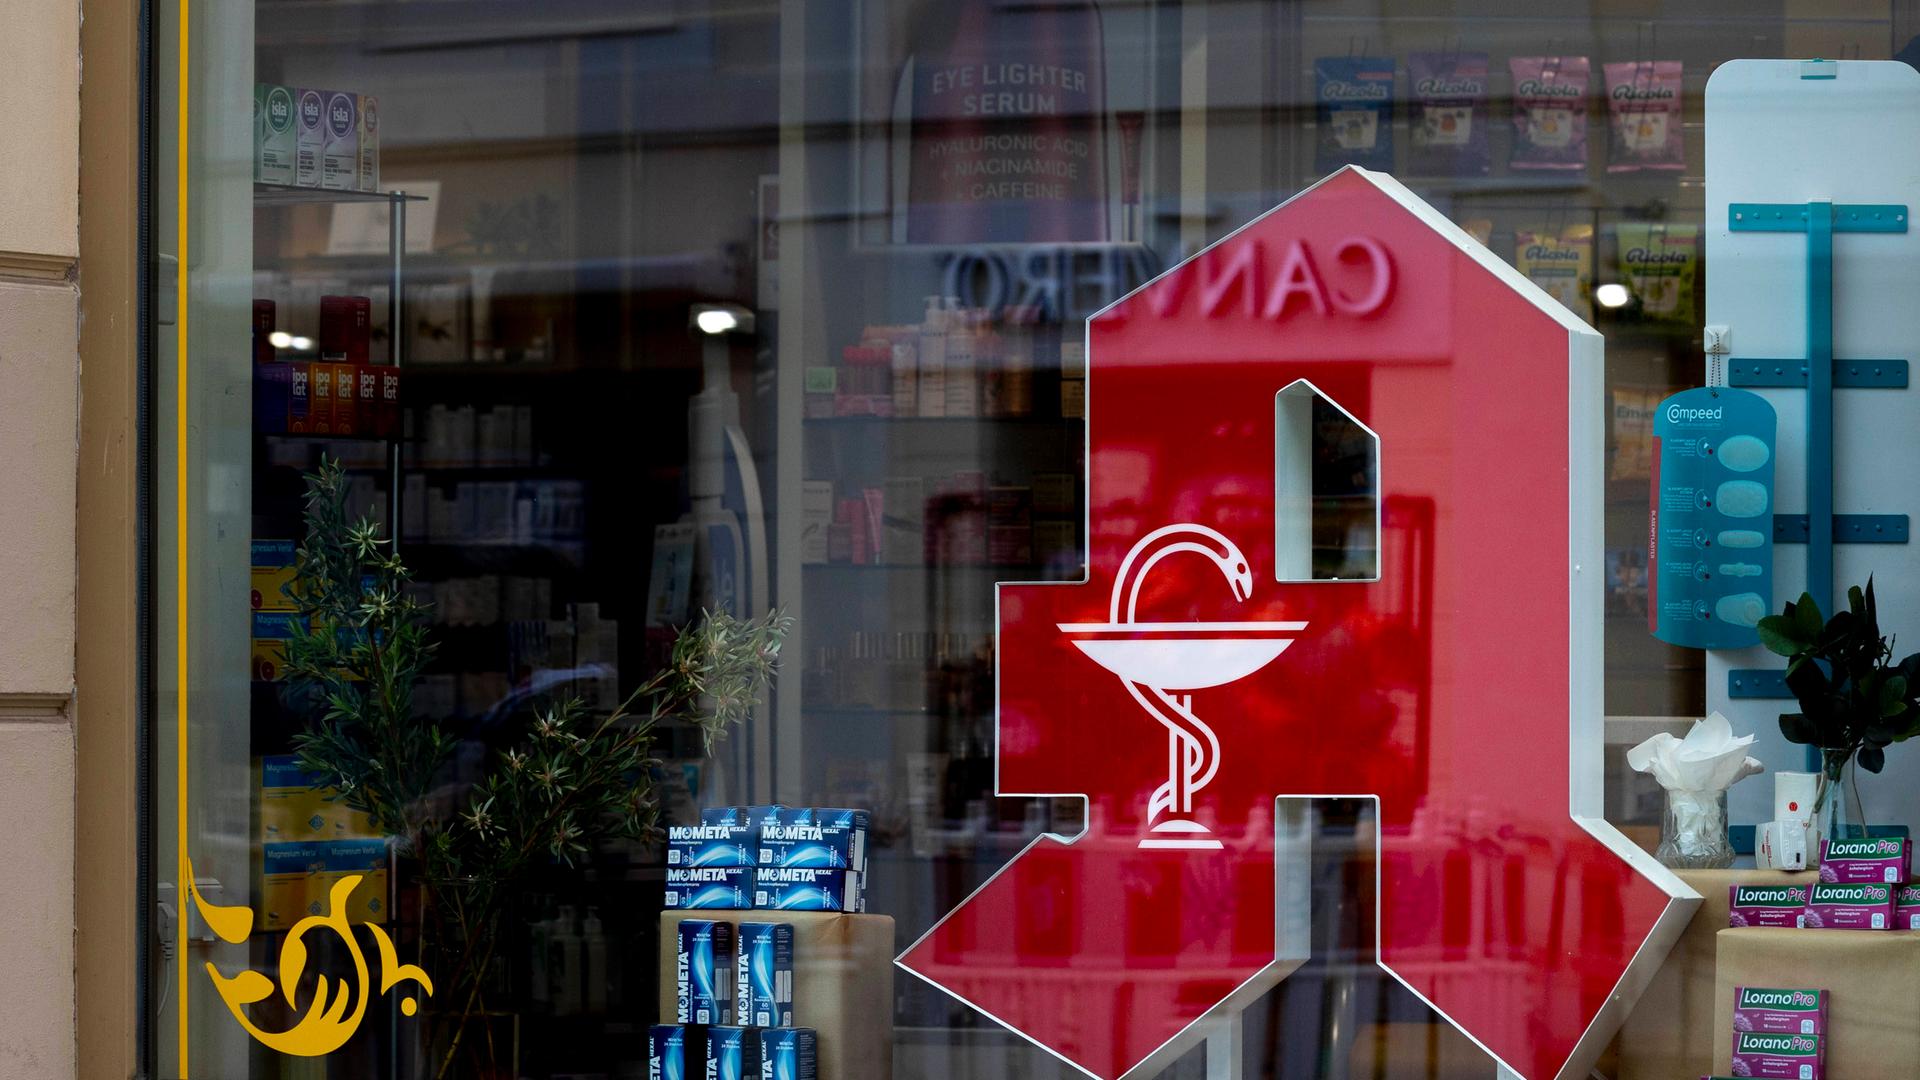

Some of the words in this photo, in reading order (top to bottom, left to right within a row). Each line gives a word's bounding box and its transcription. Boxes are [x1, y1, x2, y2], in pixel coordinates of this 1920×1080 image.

[932, 66, 976, 94] EYE
[983, 63, 1086, 93] LIGHTER
[1323, 81, 1385, 98] Ricola
[1418, 79, 1481, 95] Ricola
[1519, 81, 1579, 97] Ricola
[1612, 84, 1673, 100] Ricola
[271, 101, 287, 116] isla
[304, 101, 319, 116] isla
[963, 92, 1056, 116] SERUM
[332, 107, 349, 122] isla
[929, 134, 1047, 160] HYALURONIC
[1053, 137, 1088, 158] ACID
[955, 158, 1078, 180] NIACINAMIDE
[970, 182, 1065, 201] CAFFEINE
[1525, 245, 1580, 260] Ricola
[1626, 248, 1687, 264] Ricola
[1667, 404, 1722, 424] Compeed
[669, 826, 730, 840] MOMETA
[762, 826, 823, 841] MOMETA
[667, 868, 727, 882] MOMETA
[757, 868, 816, 882] MOMETA
[677, 951, 689, 1023] MOMETA
[738, 953, 749, 1026] MOMETA
